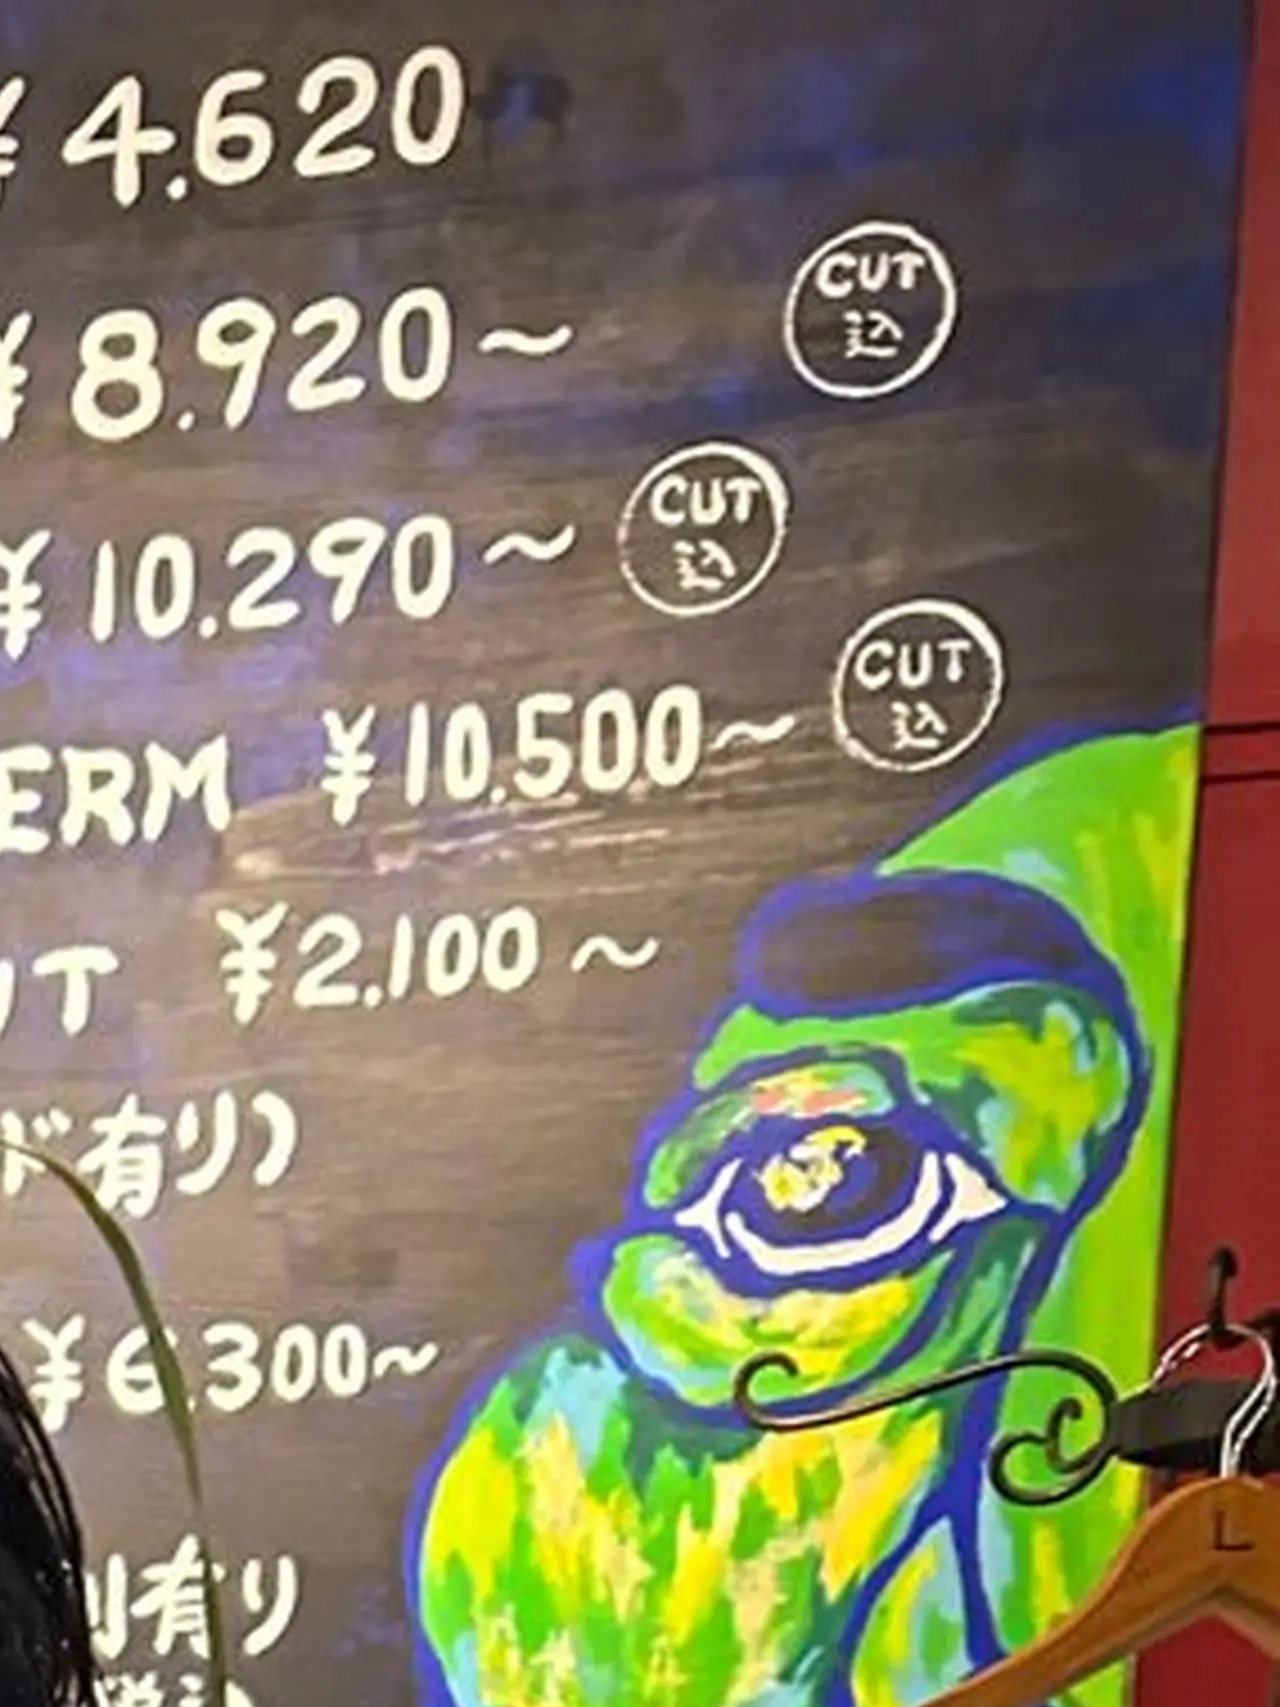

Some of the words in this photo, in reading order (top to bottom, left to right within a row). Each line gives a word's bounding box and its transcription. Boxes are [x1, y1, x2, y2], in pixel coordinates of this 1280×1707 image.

[816, 251, 925, 298] CUT
[649, 474, 761, 525] CUT
[853, 639, 971, 689] CUT
[1215, 1511, 1254, 1550] L
